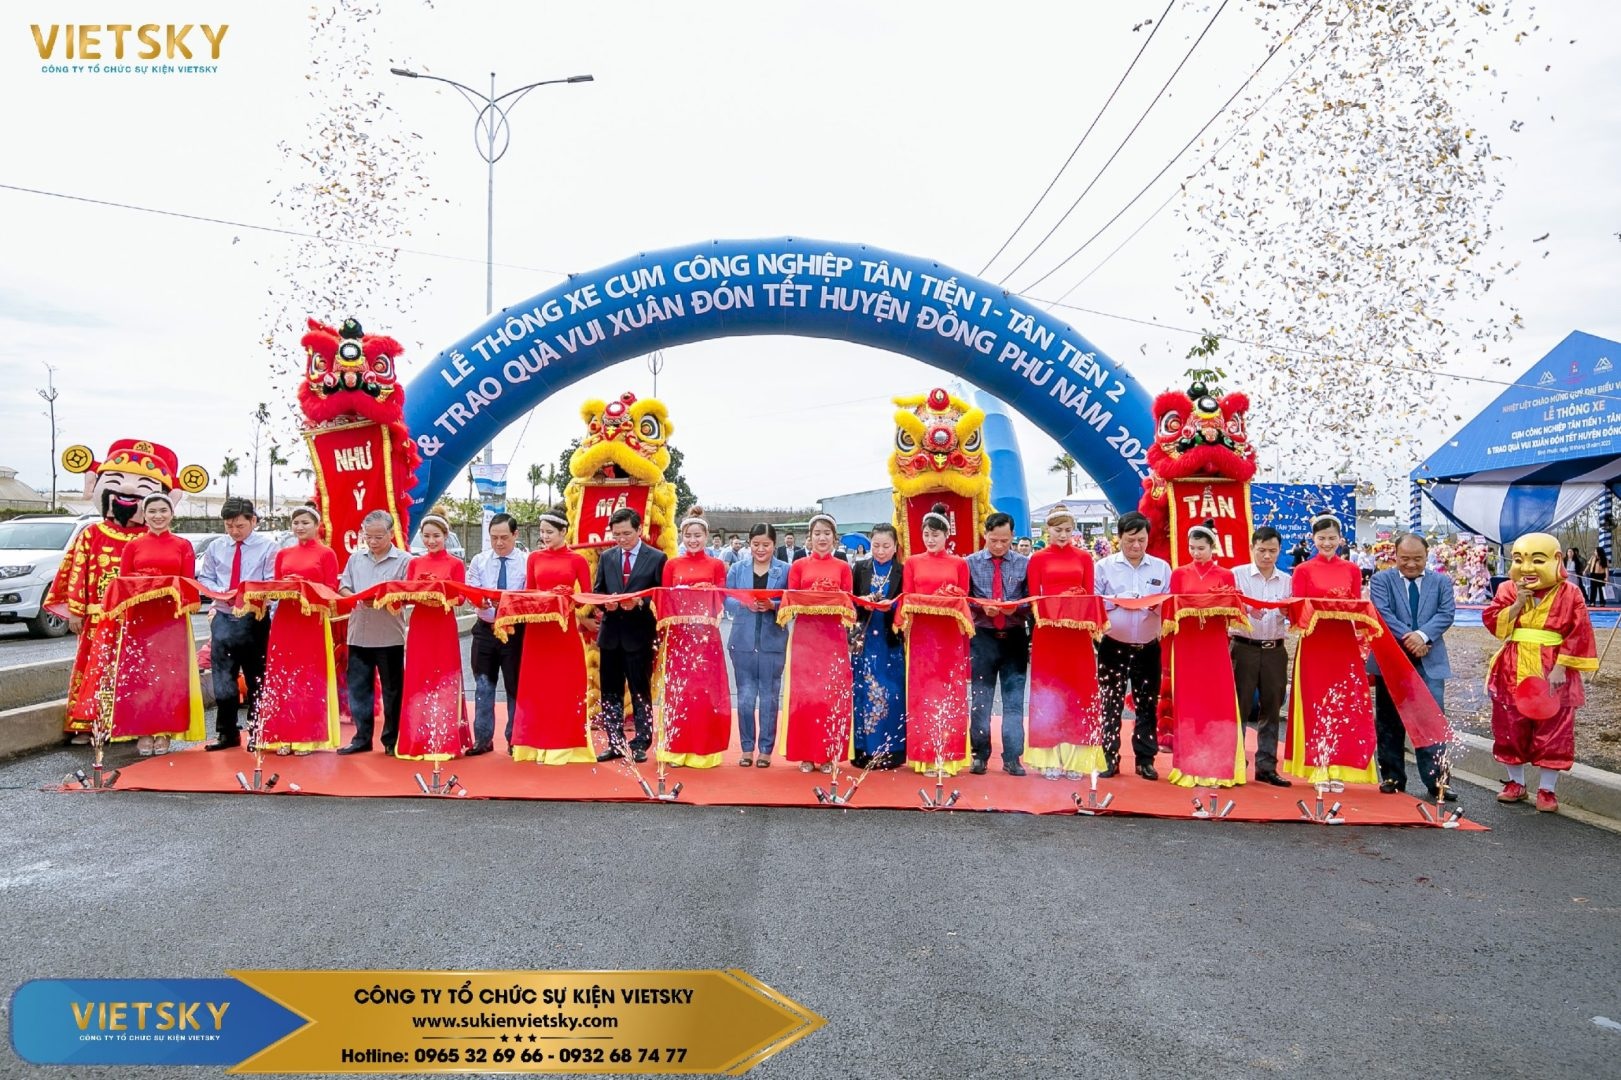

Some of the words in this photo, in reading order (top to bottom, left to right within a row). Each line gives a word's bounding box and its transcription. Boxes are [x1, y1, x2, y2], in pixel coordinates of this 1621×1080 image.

[441, 350, 475, 388] LỄ
[471, 299, 563, 361] THÔNG
[563, 284, 602, 315] XE
[605, 265, 666, 298] CỤM
[673, 254, 750, 283] CÔNG
[757, 251, 853, 283] NGHIỆP
[860, 259, 912, 291] TÂN
[920, 276, 976, 311] TIẾN
[980, 297, 993, 317] 1
[1007, 308, 1056, 351] TÂN
[1057, 340, 1109, 389] TIẾN
[1105, 380, 1126, 403] 2
[417, 434, 445, 457] &
[433, 376, 502, 435] TRAO
[503, 338, 562, 384] QUÀ
[555, 319, 606, 354] VUI
[606, 294, 685, 337] XUÂN
[691, 280, 755, 315] ĐÓN
[762, 273, 812, 307] TẾT
[819, 285, 910, 323] HUYỆN
[916, 303, 997, 355] ĐỒNG
[997, 341, 1054, 386] PHÚ
[1049, 376, 1113, 433] NĂM
[1544, 405, 1555, 421] LỄ
[1556, 402, 1590, 419] THÔNG
[1592, 400, 1606, 412] XE
[1567, 419, 1581, 429] TÂN
[1582, 416, 1597, 427] TIẾN
[1565, 431, 1577, 442] TẾT
[334, 440, 373, 472] NHƯ
[352, 481, 366, 511] Ý
[1212, 528, 1234, 558] ÀI
